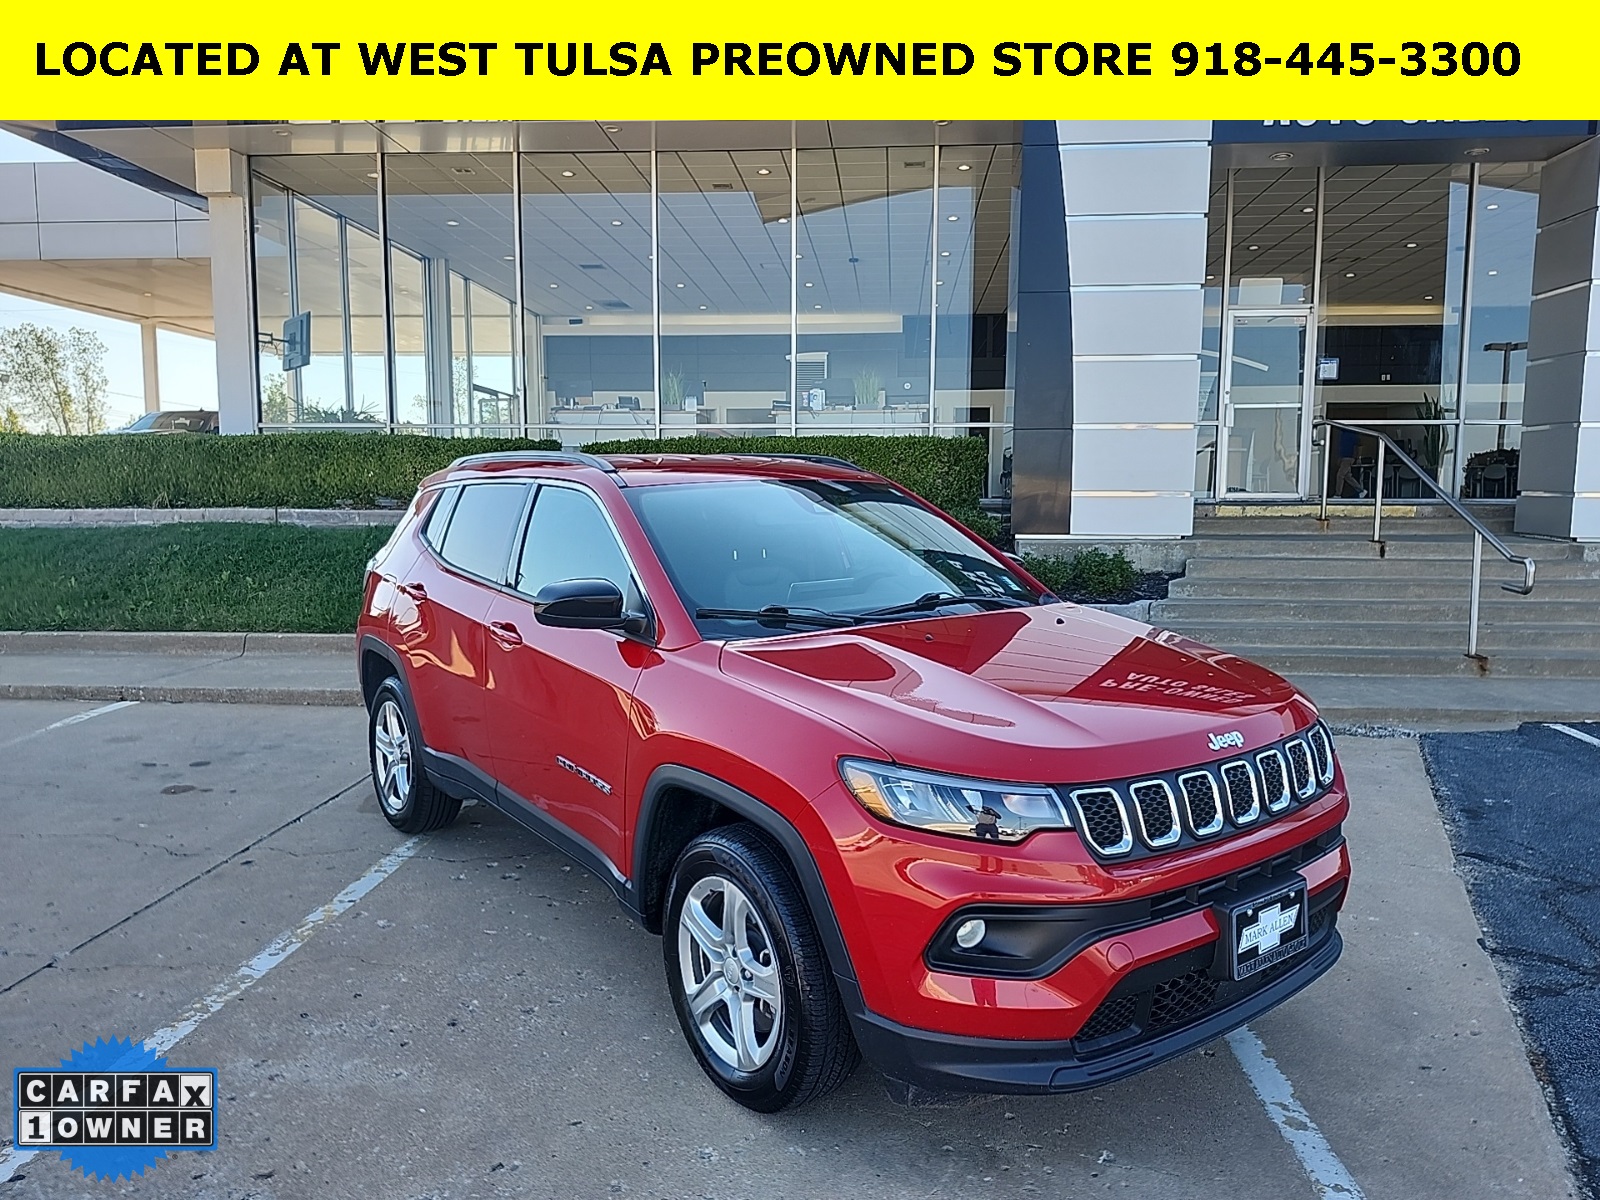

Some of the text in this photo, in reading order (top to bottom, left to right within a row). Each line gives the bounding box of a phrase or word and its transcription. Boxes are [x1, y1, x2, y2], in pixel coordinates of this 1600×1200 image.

[1207, 730, 1245, 751] Jeep
[1244, 912, 1295, 945] MARK ALLEN
